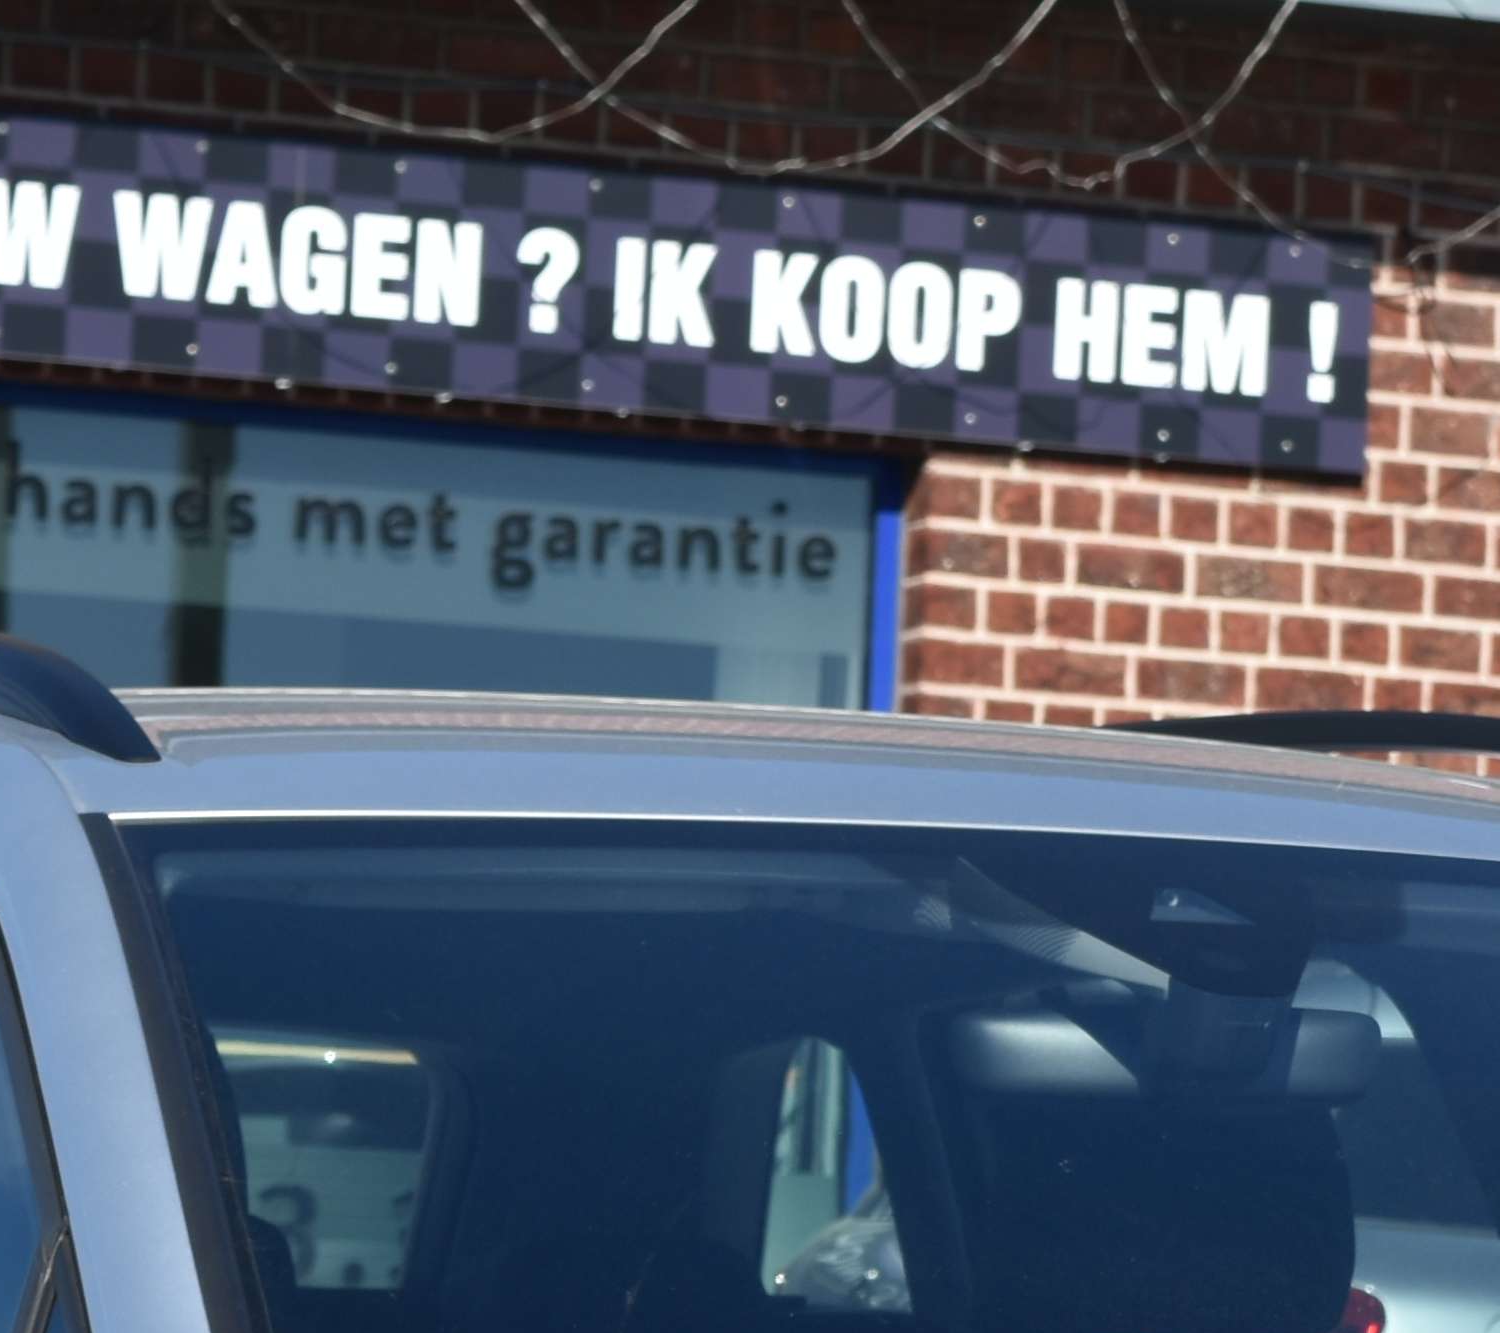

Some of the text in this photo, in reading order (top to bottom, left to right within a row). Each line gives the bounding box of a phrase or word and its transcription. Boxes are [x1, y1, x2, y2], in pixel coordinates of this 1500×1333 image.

[114, 189, 482, 327] WAGEN
[516, 227, 581, 335] ?
[612, 237, 719, 349] IK
[748, 248, 1023, 373] KOOP
[1052, 277, 1271, 398] HEM
[1303, 299, 1340, 404] !
[296, 492, 458, 552] met
[494, 500, 837, 589] garantie
